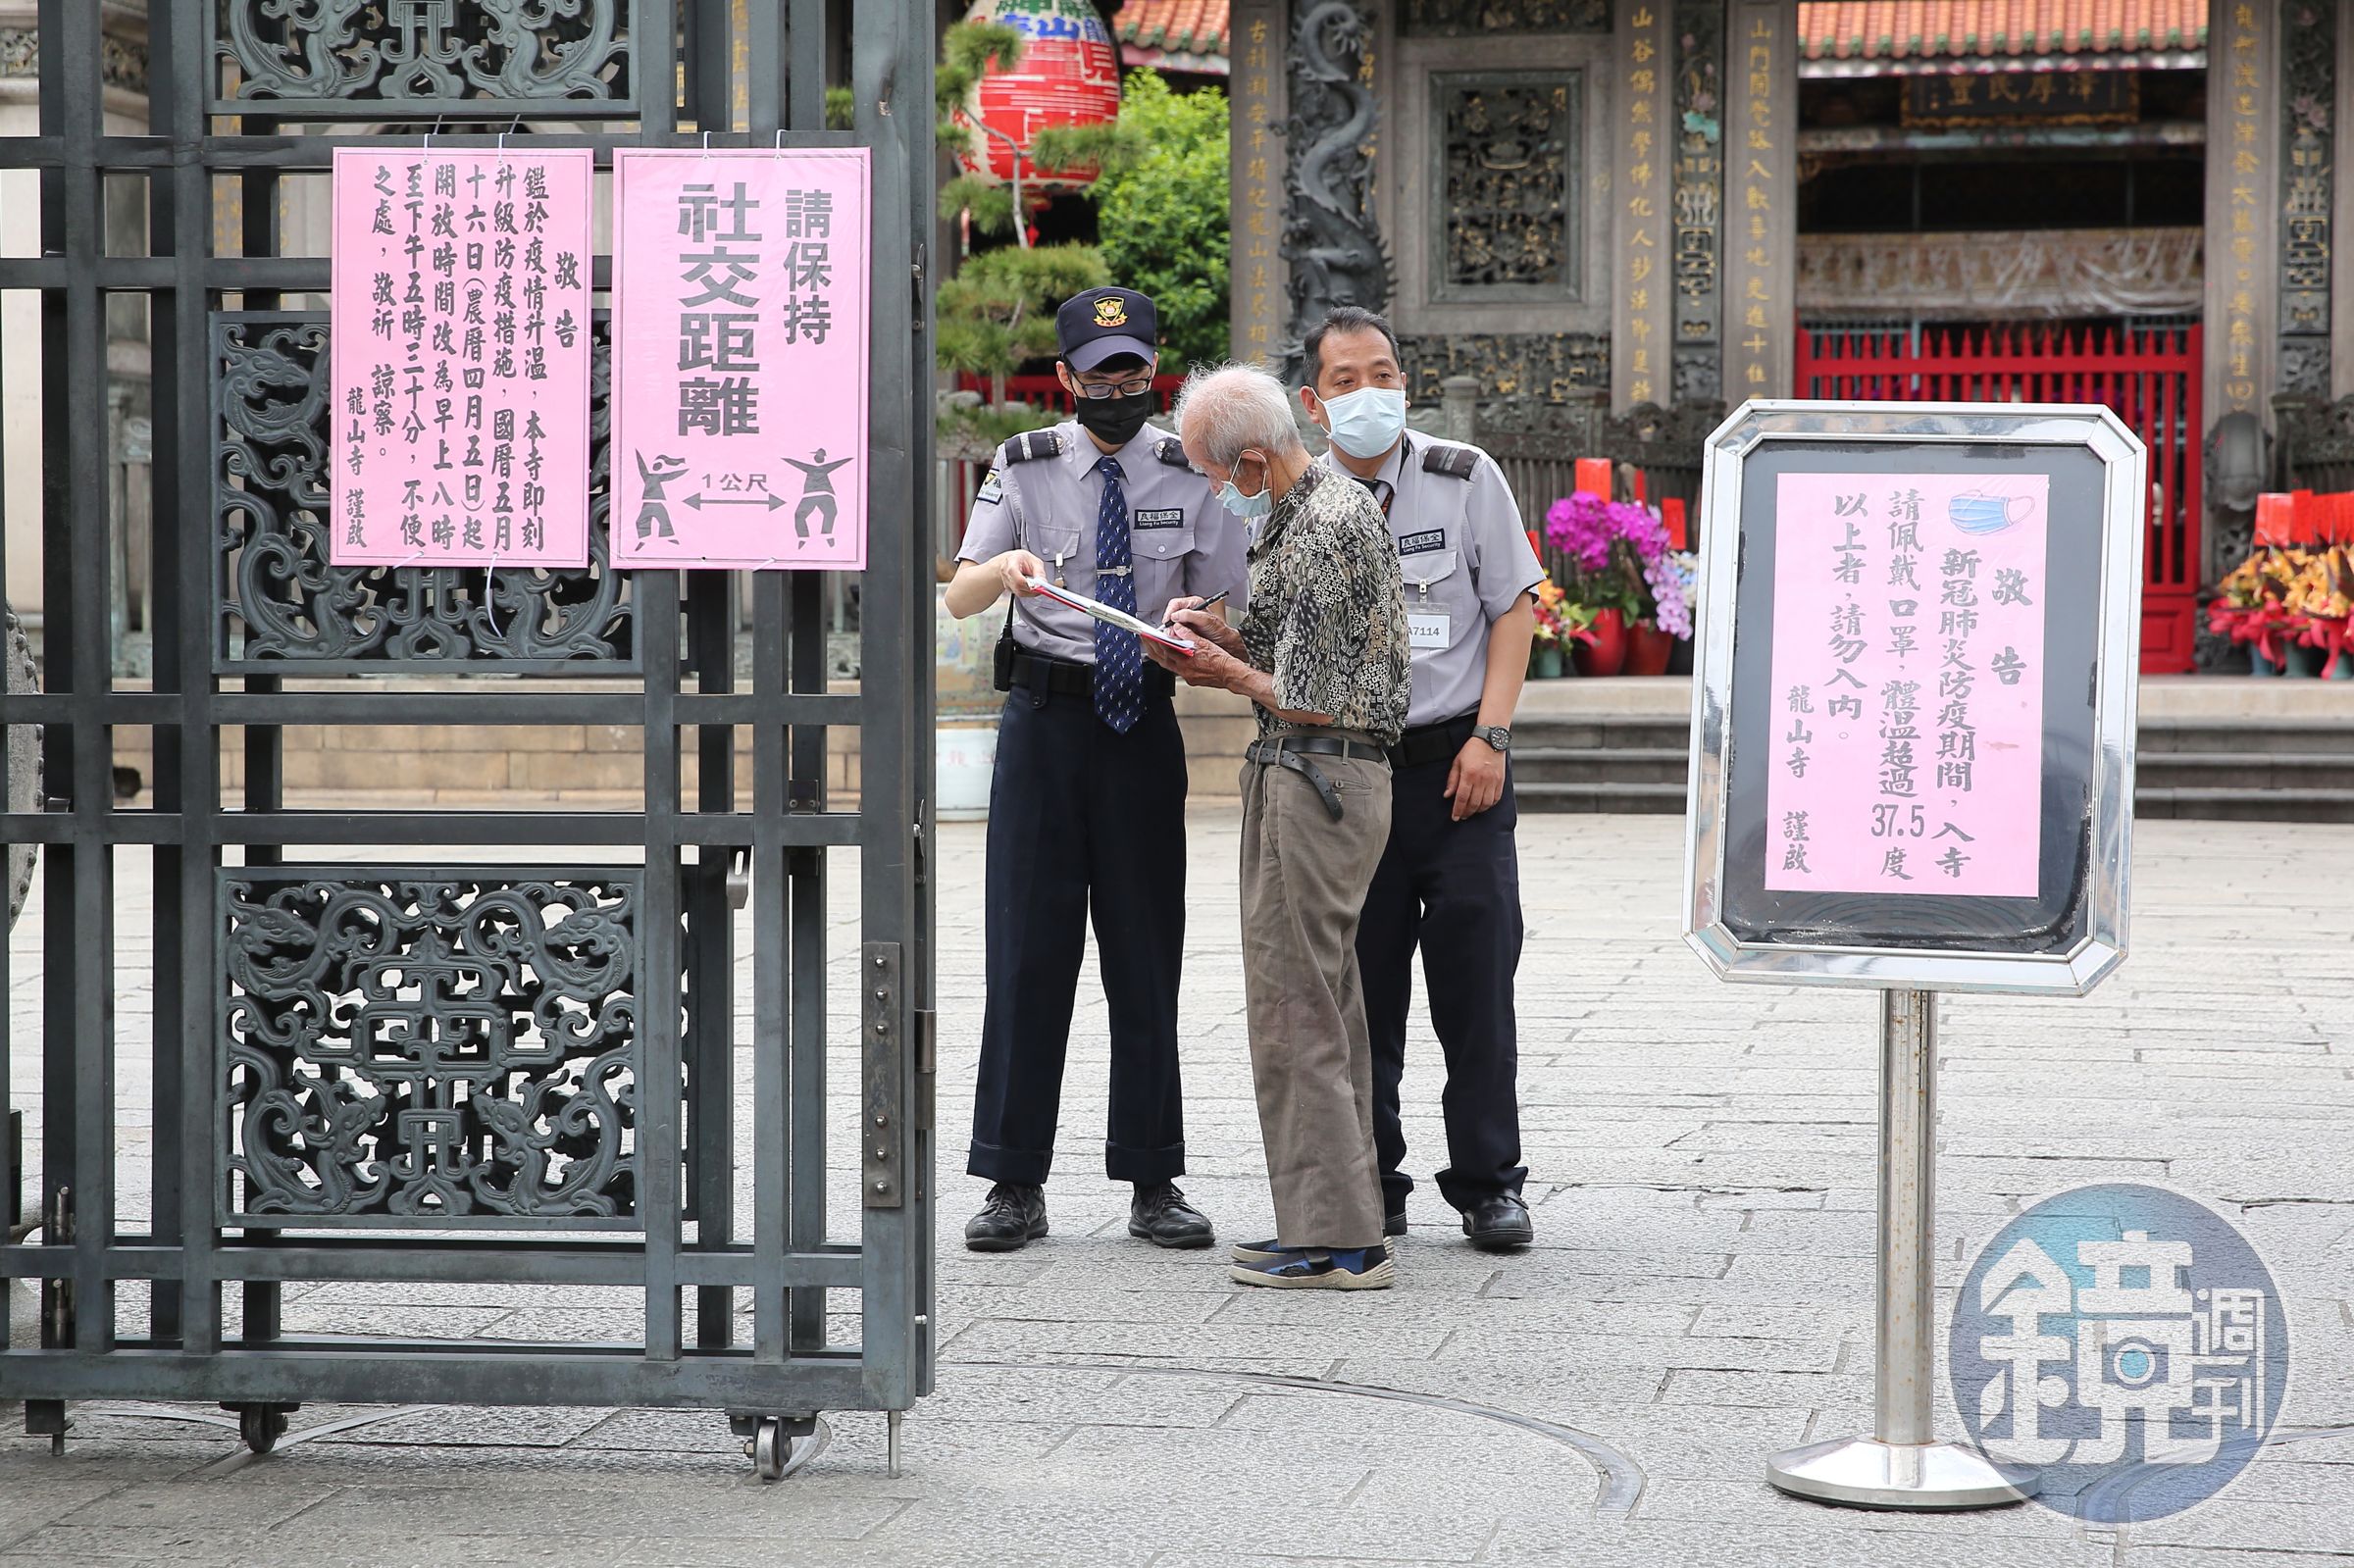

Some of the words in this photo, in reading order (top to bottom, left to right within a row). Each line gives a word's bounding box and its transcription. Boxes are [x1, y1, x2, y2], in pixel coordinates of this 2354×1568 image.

[432, 164, 458, 550] 開放時間改為早上八時
[678, 182, 762, 436] 社交距離
[785, 189, 833, 344] 請保持
[702, 474, 768, 492] 1公尺
